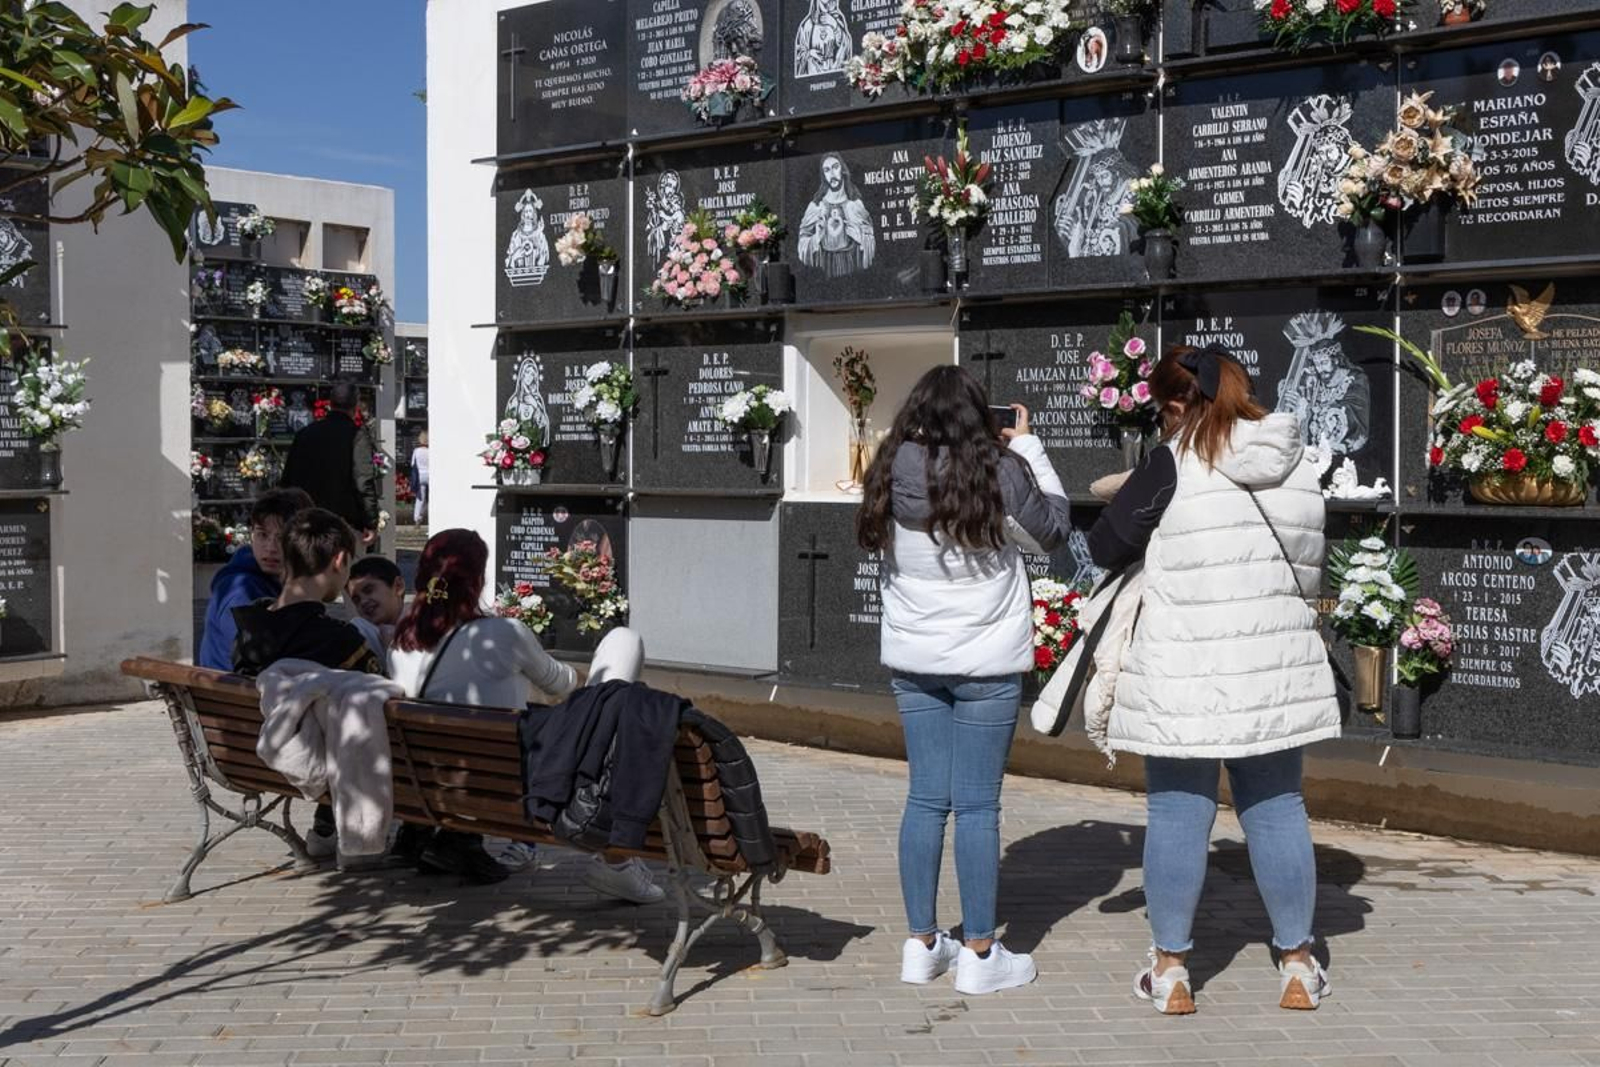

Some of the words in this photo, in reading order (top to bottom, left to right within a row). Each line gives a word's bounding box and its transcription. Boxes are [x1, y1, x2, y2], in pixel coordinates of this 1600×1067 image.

[554, 25, 593, 44] NICOLÁS
[539, 46, 569, 61] CAÑAS
[570, 39, 608, 56] ORTEGA
[543, 72, 582, 87] QUEREMOS
[542, 87, 569, 100] SIEMPRE
[1211, 103, 1249, 119] VALENTIN
[1473, 93, 1546, 113] MARIANO
[1192, 121, 1229, 137] CARRILLO
[1231, 116, 1268, 133] SERRANO
[1479, 111, 1539, 130] ESPAÑA
[992, 131, 1033, 150] LORENZO
[892, 149, 910, 164] ANA
[1003, 144, 1044, 163] SANCHEZ
[1221, 148, 1238, 162] ANA
[1489, 147, 1538, 161] 3-3-2015
[1187, 163, 1238, 181] ARMENTEROS
[1240, 160, 1273, 175] ARANDA
[1504, 164, 1518, 174] 76
[1521, 158, 1556, 173] AÑOS
[864, 166, 895, 185] MEGÍAS
[1527, 177, 1565, 190] HIJOS
[717, 180, 737, 194] JOSE
[1002, 182, 1021, 197] ANA
[569, 196, 590, 210] PEDRO
[1213, 190, 1245, 206] CARMEN
[1512, 192, 1565, 207] SIEMPRE
[881, 213, 890, 228] D.
[896, 212, 905, 227] E.
[987, 209, 1037, 226] CABALLERO
[1184, 208, 1221, 224] CARRILLO
[1223, 203, 1275, 221] ARMENTEROS
[1476, 207, 1561, 224] RECORDARAN
[1196, 317, 1207, 332] D.
[1211, 316, 1221, 331] E.
[1224, 316, 1233, 331] P.
[1050, 334, 1062, 349] D.
[1064, 333, 1074, 348] E.
[1076, 332, 1085, 347] P.
[1185, 332, 1244, 349] FRANCISCO
[1468, 328, 1503, 341] JOSEFA
[1446, 341, 1484, 355] FLORES
[1486, 339, 1526, 354] MUÑOZ
[703, 352, 712, 366] D.
[712, 352, 721, 365] E.
[723, 352, 730, 365] P.
[1055, 350, 1080, 365] JOSE
[699, 366, 734, 380] DOLORES
[1016, 366, 1067, 382] ALMAZAN
[688, 382, 723, 395] PEDROSA
[687, 420, 713, 433] AMATE
[1029, 412, 1068, 426] ARCON
[857, 562, 880, 576] JOSE
[1462, 555, 1513, 571] ANTONIO
[1440, 571, 1477, 588] ARCOS
[1483, 573, 1536, 590] CENTENO
[1500, 593, 1522, 605] 2015
[1465, 606, 1508, 623] TERESA
[1494, 627, 1537, 643] SASTRE
[1462, 643, 1472, 655] 11
[1499, 645, 1521, 657] 2017
[1460, 658, 1497, 672] SIEMPRE
[1500, 660, 1513, 673] OS
[1451, 672, 1521, 689] RECORDAREMOS
